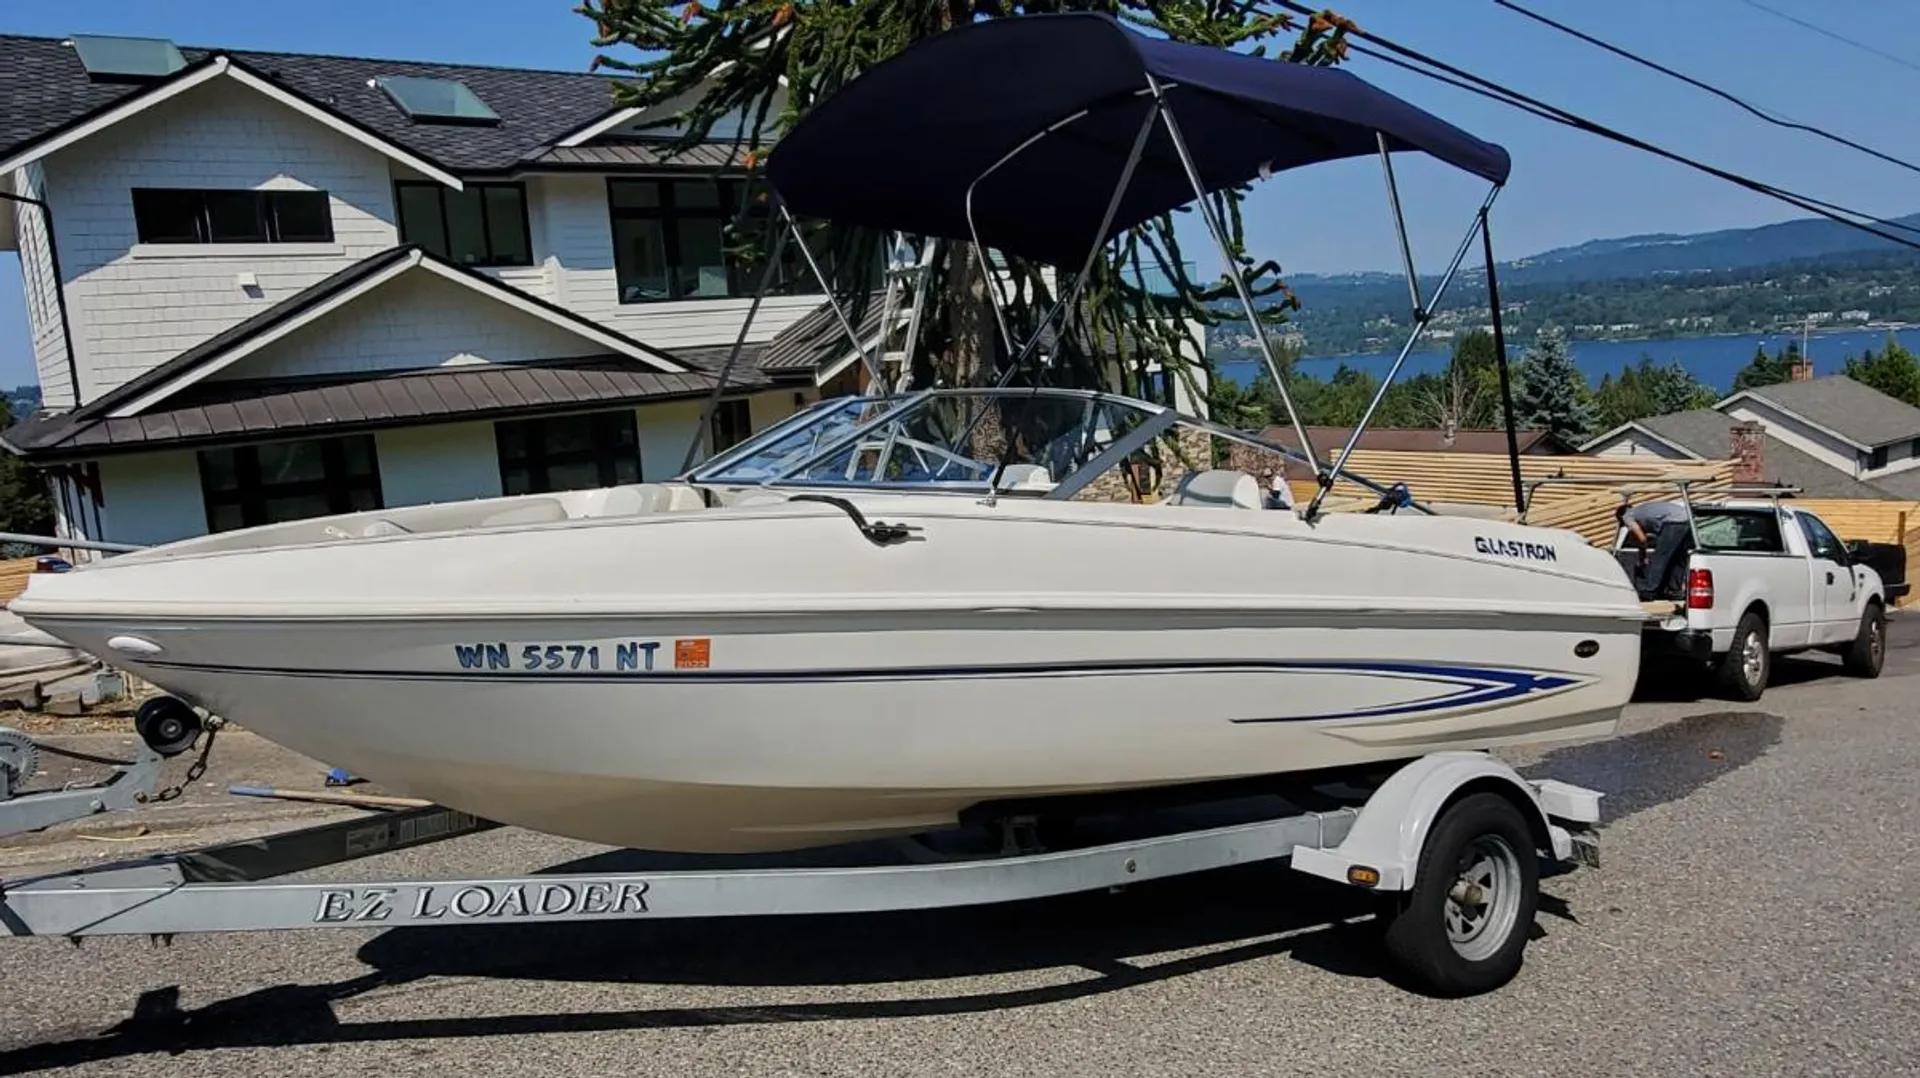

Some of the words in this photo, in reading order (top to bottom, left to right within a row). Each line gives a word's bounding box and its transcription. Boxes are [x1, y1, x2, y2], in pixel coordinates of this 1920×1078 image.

[1475, 536, 1557, 561] GLASTRON
[455, 643, 510, 669] WN
[522, 645, 600, 670] 5571
[616, 642, 660, 671] NT
[313, 887, 398, 922] EZ
[411, 882, 650, 919] LOADER
